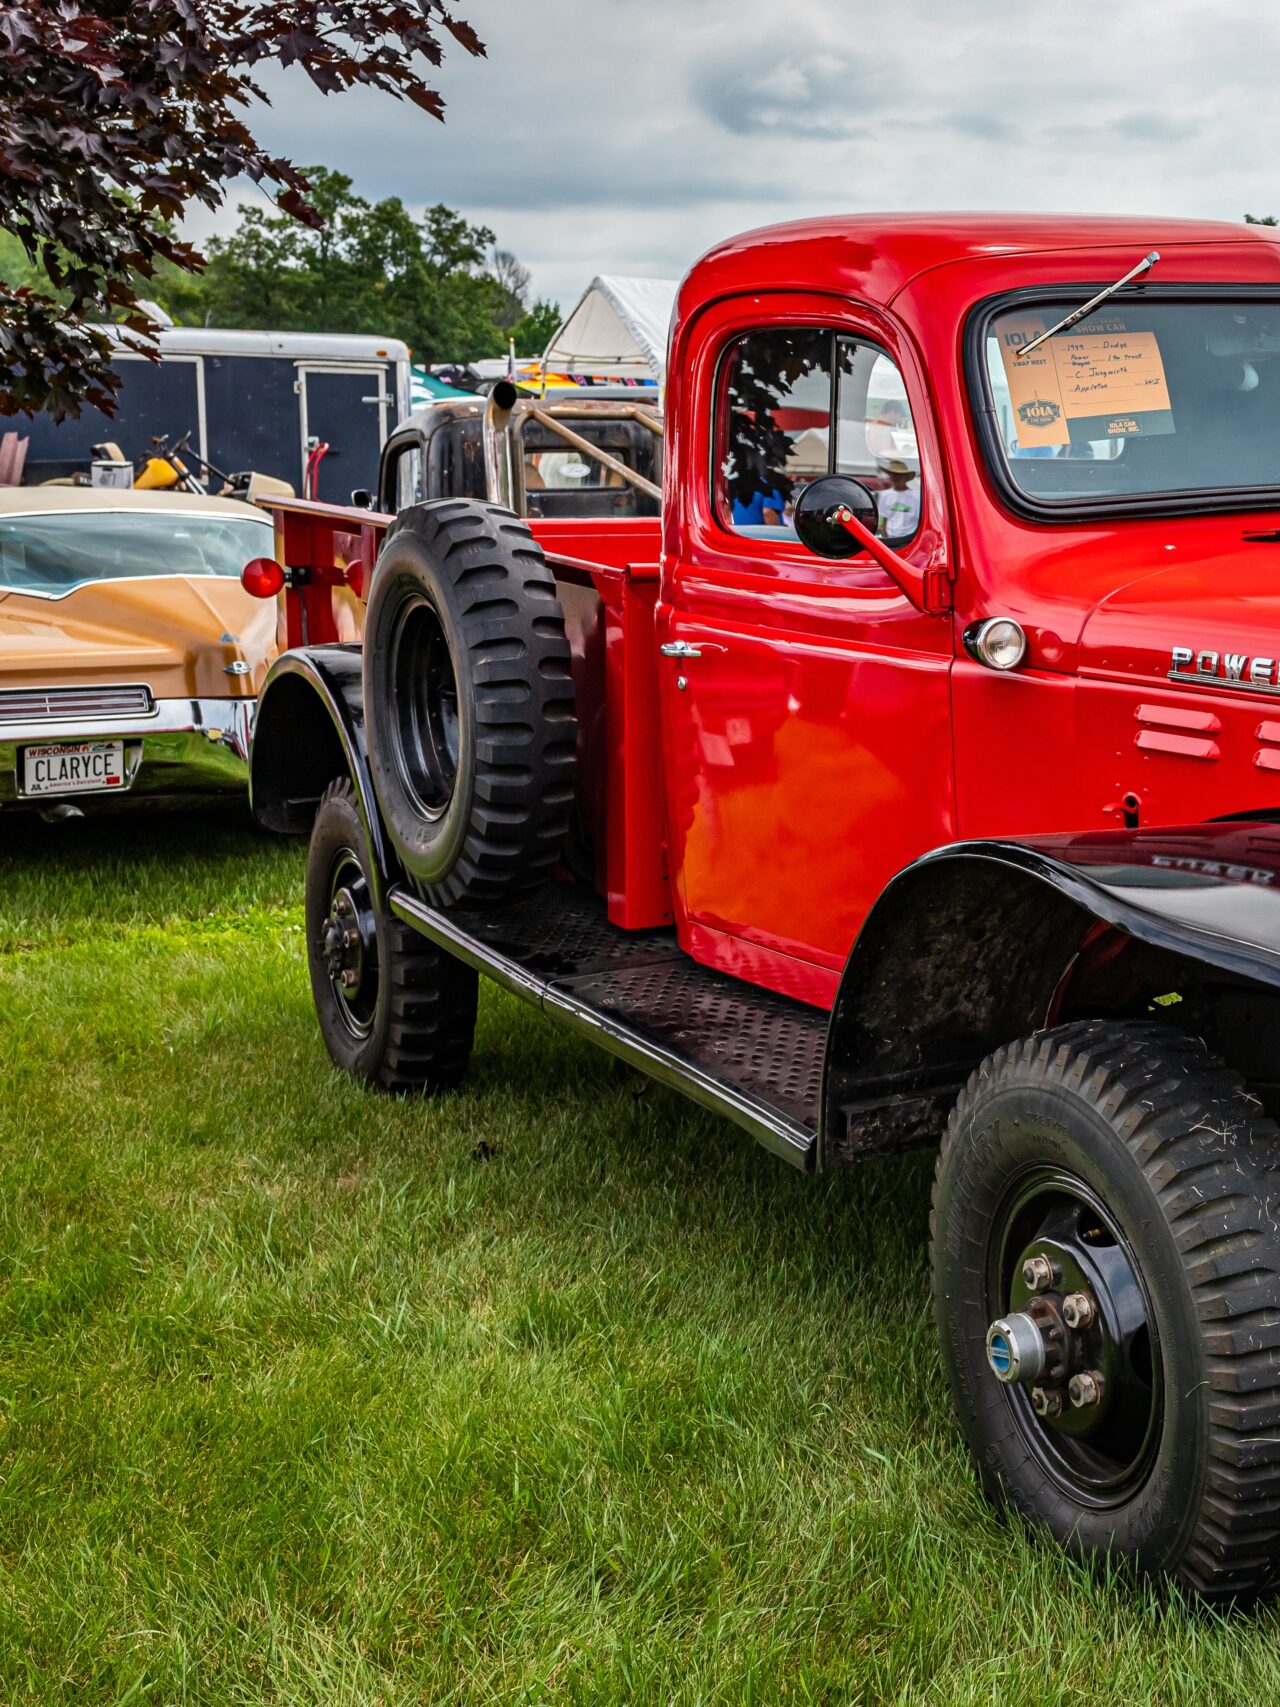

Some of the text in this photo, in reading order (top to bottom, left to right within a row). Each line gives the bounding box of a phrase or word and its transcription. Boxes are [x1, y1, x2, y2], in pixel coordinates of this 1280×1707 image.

[1076, 323, 1127, 333] SHOW CAR
[1103, 341, 1129, 350] Dodge
[1075, 383, 1108, 393] Appleton
[1026, 406, 1053, 417] IOLA
[28, 744, 81, 758] WISCONSIN
[35, 753, 114, 782] CLARYCE
[31, 783, 42, 792] JUL
